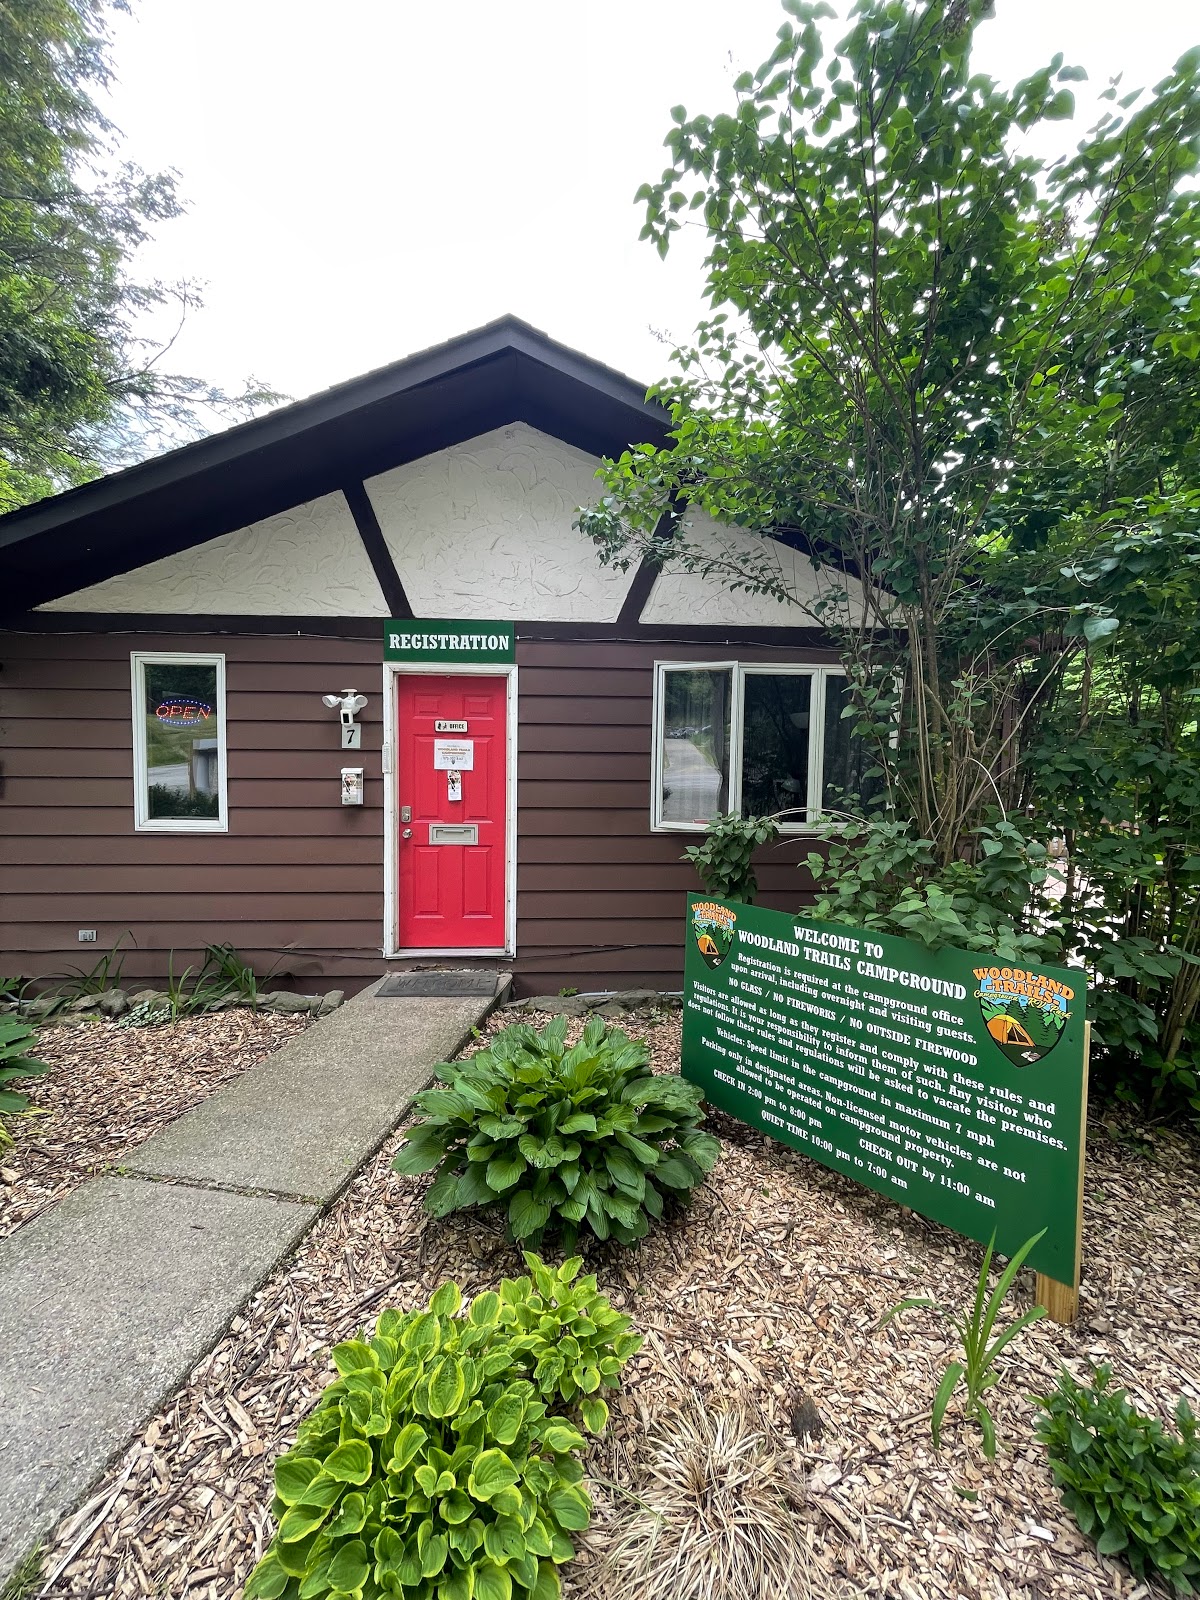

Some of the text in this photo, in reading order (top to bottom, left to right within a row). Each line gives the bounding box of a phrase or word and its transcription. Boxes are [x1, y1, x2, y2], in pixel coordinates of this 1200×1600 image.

[389, 633, 510, 651] REGISTRATION
[155, 705, 211, 720] OPEN
[346, 729, 356, 745] 7
[691, 902, 737, 922] WOODLAND
[793, 925, 884, 959] WELCOME TO
[737, 929, 967, 1000] WOODLAND TRAILS CAMPGROUND
[737, 952, 964, 1026] Registration is required at the campground office
[973, 967, 1075, 1000] WOODLAND
[728, 976, 739, 987] NO
[740, 980, 763, 996] GLASS
[772, 991, 784, 1003] NO
[786, 996, 836, 1021] FIREWORKS
[849, 1016, 863, 1030] NO
[866, 1022, 911, 1046] OUTSIDE
[914, 1037, 978, 1066] FIREWOOD
[730, 963, 977, 1044] upon arrival, including overnight and visiting guests.
[1028, 998, 1047, 1009] RV
[1050, 1004, 1073, 1020] Park
[687, 999, 1068, 1151] does not follow these rules and regulations will be asked to vacate the premises.
[693, 980, 1055, 1115] Visitors are allowed as long as they register and comply with these rules and
[693, 992, 1052, 1129] regulations. It is your responsibility to inform them of such. Any visitor who
[701, 1036, 1026, 1183] Parking only in designated areas. Non-licensed motor vehicles are not
[713, 1068, 822, 1129] CHECK IN 2:00 pm to 8:00 pm
[716, 1026, 995, 1148] Vehicles: Speed limit in the campground in maximum 7 mph
[735, 1064, 955, 1168] allowed to be operated on campground property.
[761, 1109, 908, 1189] QUIET TIME 10:00 pm to 7:00 am
[859, 1138, 996, 1208] CHECK OUT by 11:00 am
